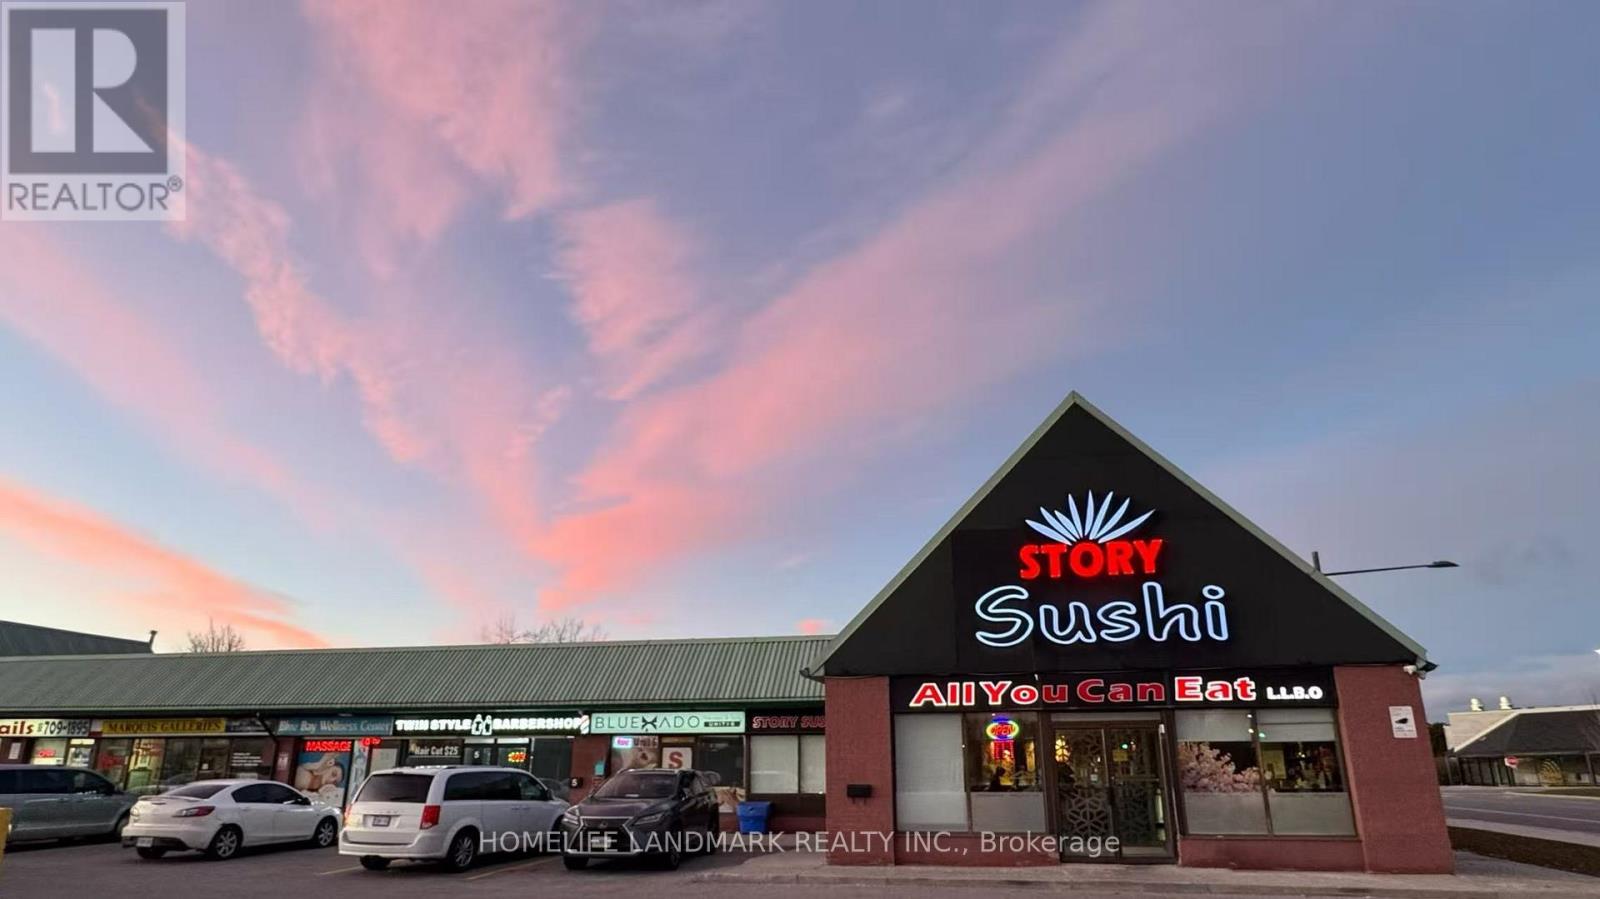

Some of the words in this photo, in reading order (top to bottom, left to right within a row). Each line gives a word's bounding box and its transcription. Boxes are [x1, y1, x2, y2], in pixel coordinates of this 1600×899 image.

[1018, 539, 1163, 580] STORY
[974, 581, 1230, 647] Sushi
[908, 681, 975, 707] All
[979, 680, 1068, 705] You
[1076, 678, 1165, 703] Can
[1174, 676, 1257, 702] Eat
[108, 721, 158, 733] MARQUIS
[160, 720, 221, 733] GALLERIES
[395, 720, 428, 732] TWIN
[430, 719, 472, 731] STYLE
[493, 717, 582, 730] BARBERSHOP
[752, 716, 799, 729] STORY
[305, 740, 352, 752] MASSAGE
